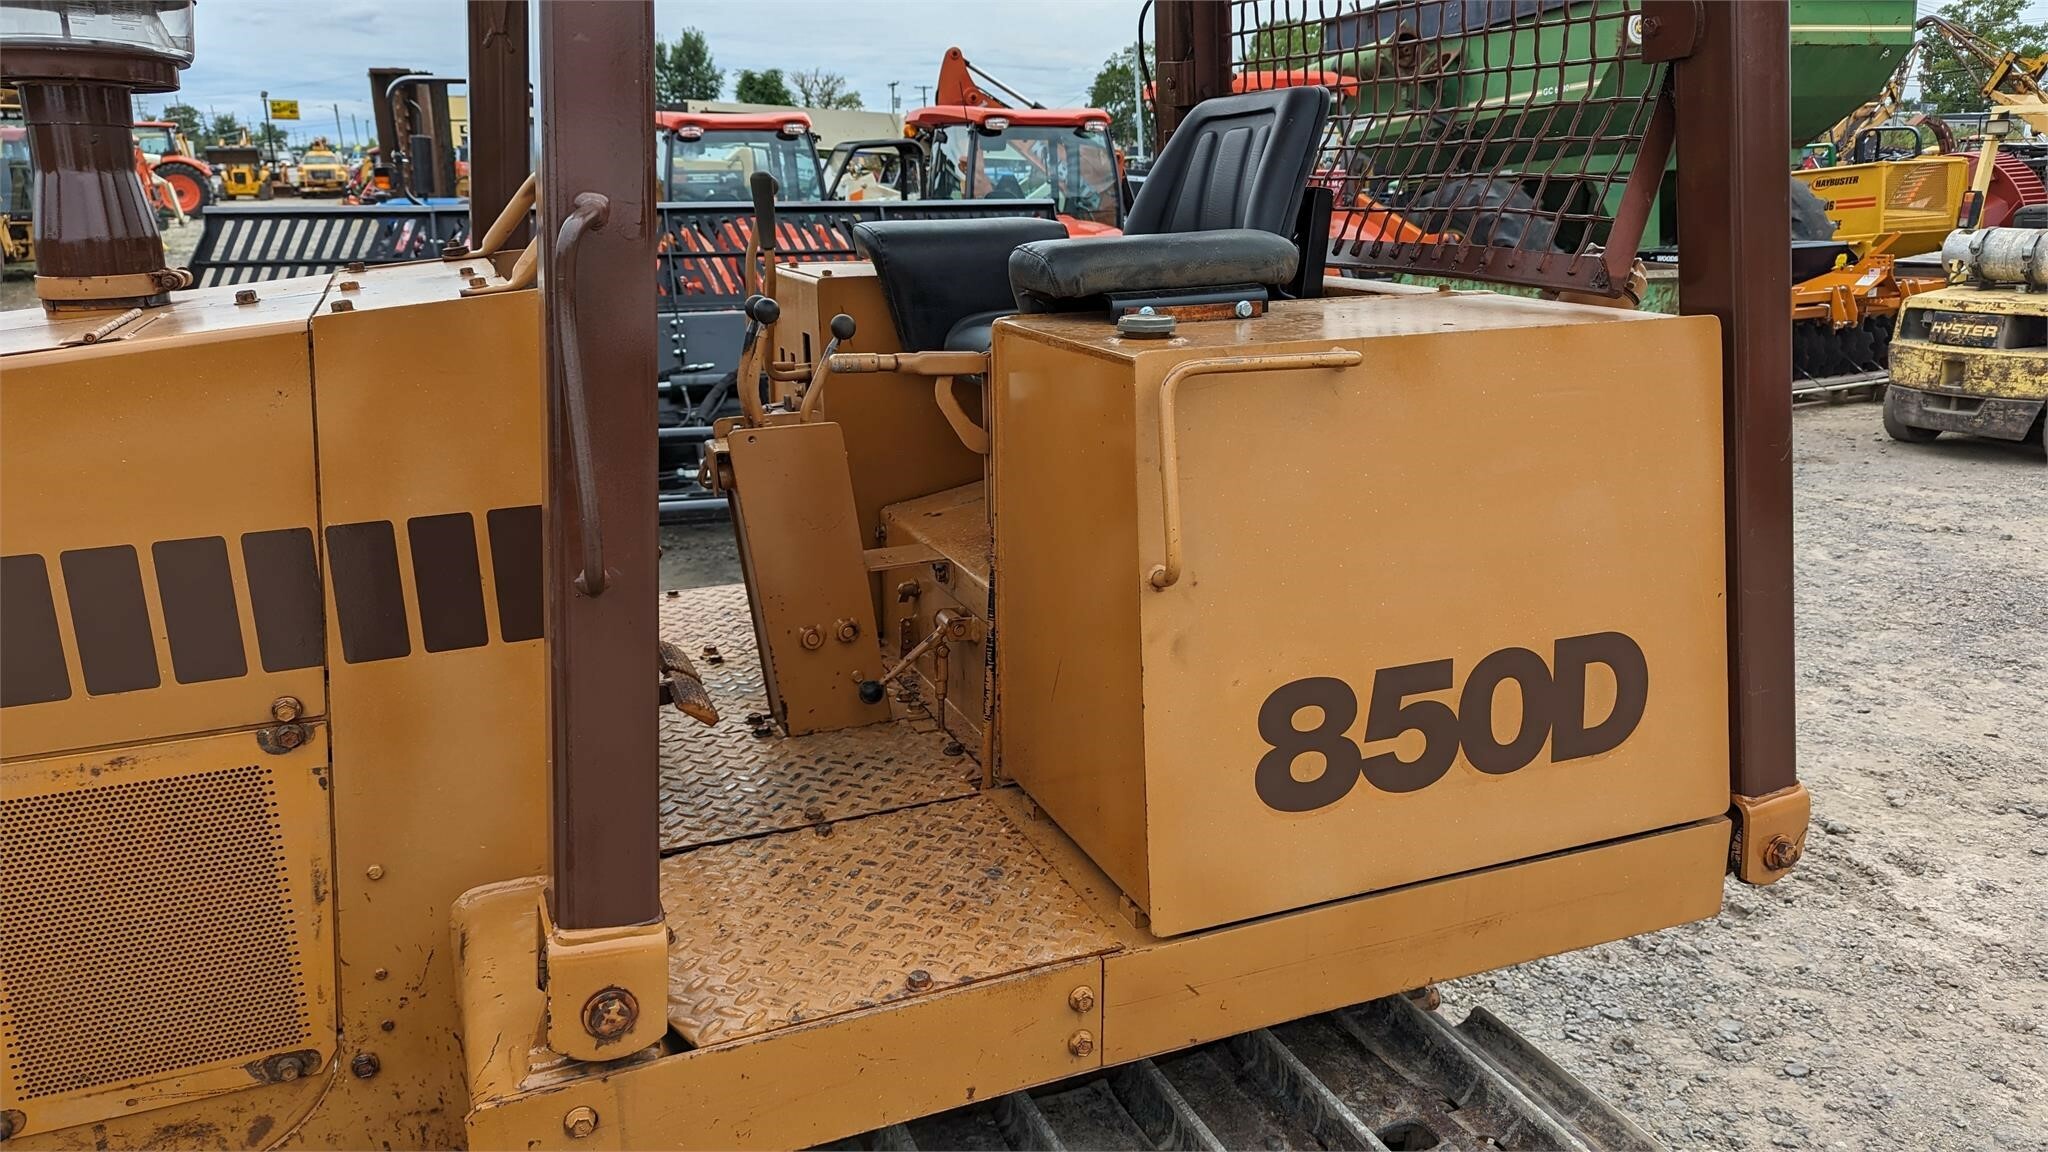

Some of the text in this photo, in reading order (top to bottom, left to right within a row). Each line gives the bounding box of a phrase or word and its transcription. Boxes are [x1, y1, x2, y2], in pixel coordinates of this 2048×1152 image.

[1543, 86, 1554, 96] GC
[1815, 175, 1859, 188] HAYBUSTER
[1930, 321, 1999, 338] HYSTER
[1254, 631, 1649, 813] 850D
